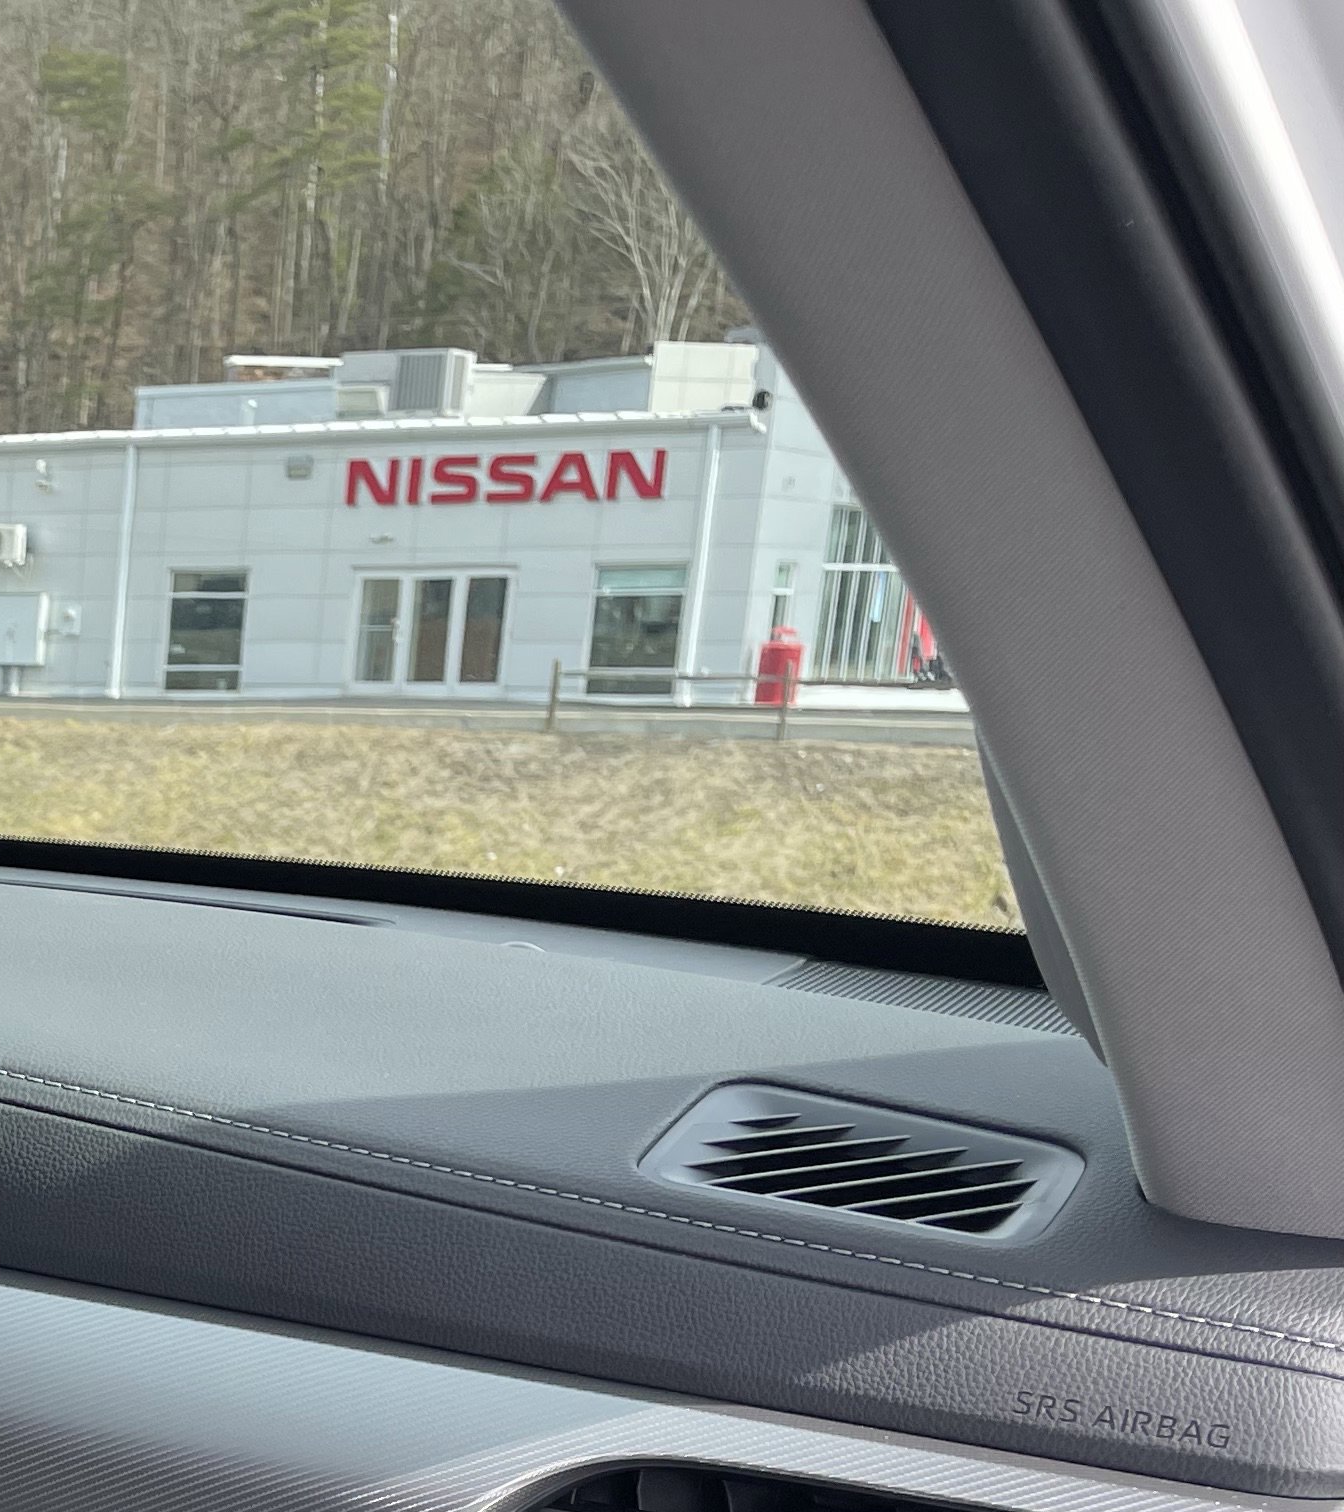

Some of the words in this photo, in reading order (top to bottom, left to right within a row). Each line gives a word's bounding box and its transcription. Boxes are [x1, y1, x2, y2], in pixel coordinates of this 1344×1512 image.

[345, 447, 667, 508] NISSAN
[1010, 1390, 1080, 1427] SRS
[1092, 1404, 1233, 1452] AIRBAG
